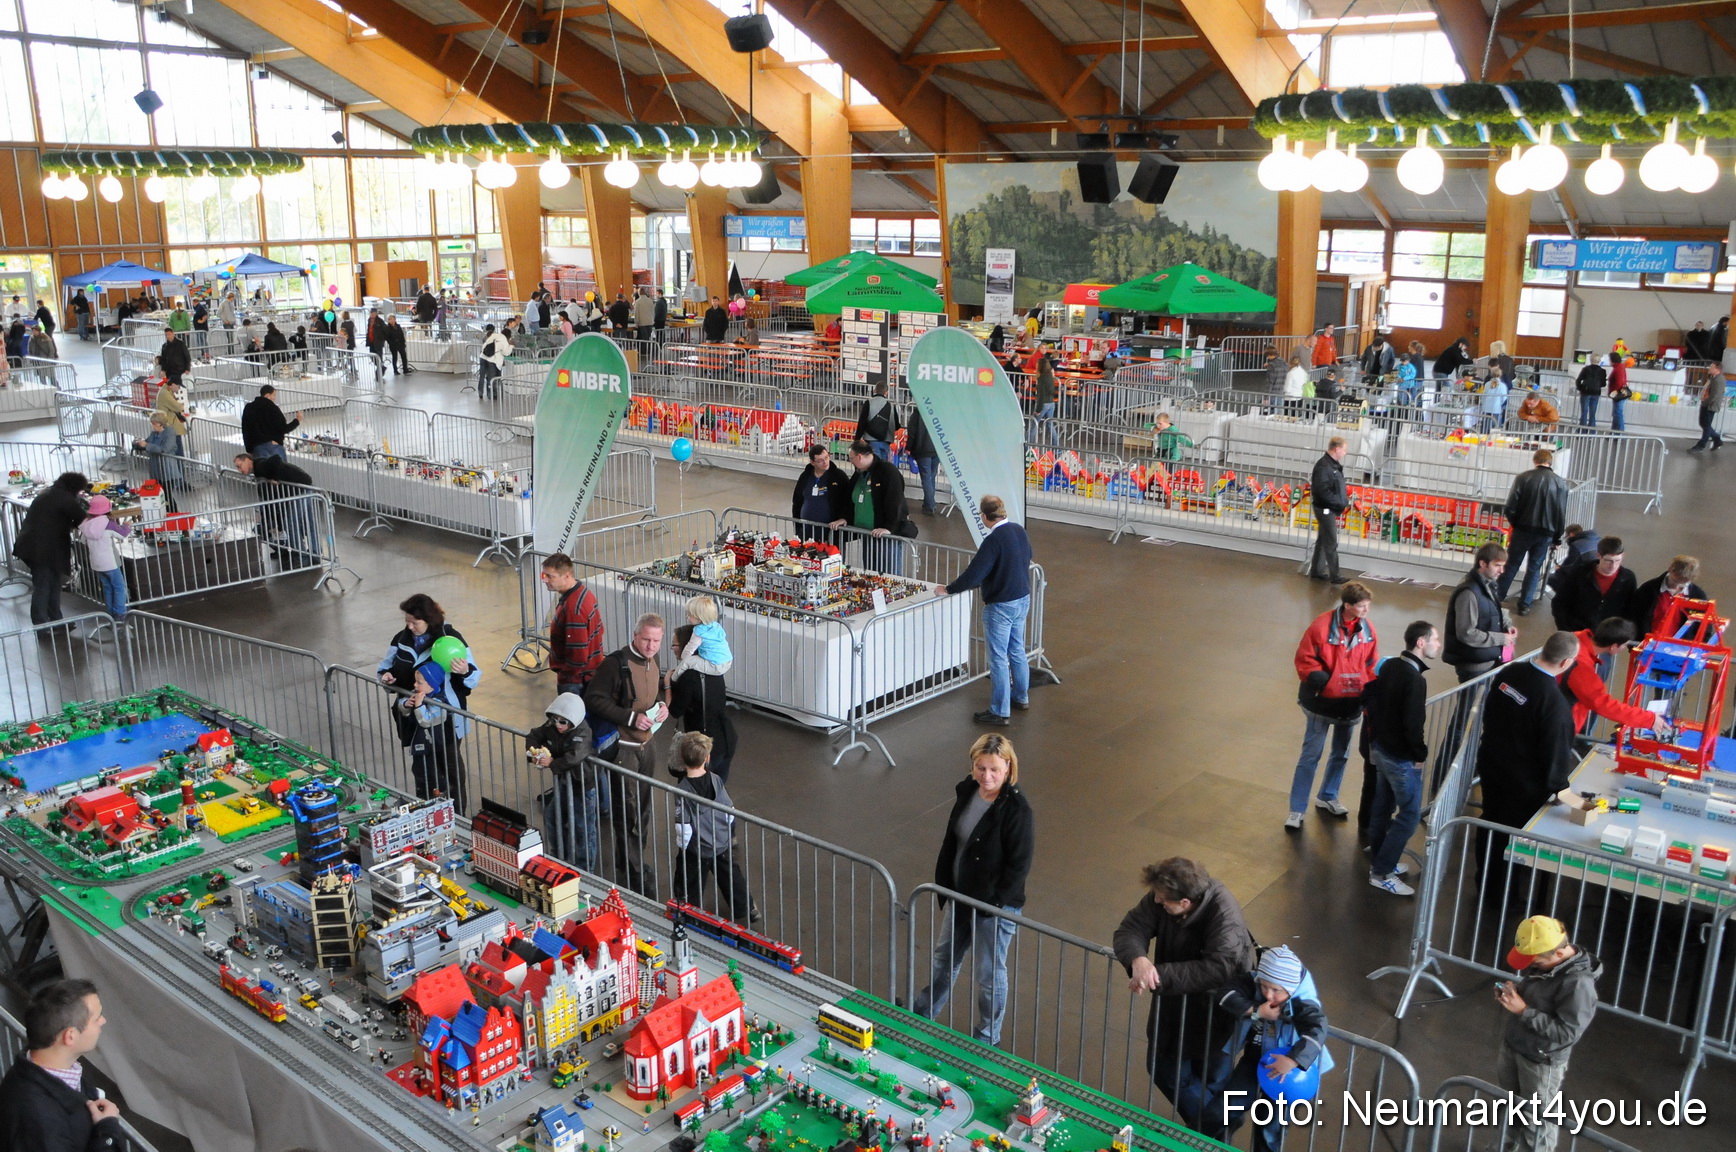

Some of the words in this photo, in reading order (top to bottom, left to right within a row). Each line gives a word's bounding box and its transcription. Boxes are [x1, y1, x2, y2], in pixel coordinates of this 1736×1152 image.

[1589, 242, 1614, 255] Wir
[1617, 241, 1664, 260] grüßen
[1582, 260, 1622, 269] unsere
[1626, 258, 1668, 270] Gäste!
[571, 370, 622, 394] MBFR
[583, 429, 609, 488] RHEINLAND
[606, 410, 618, 429] e.V.
